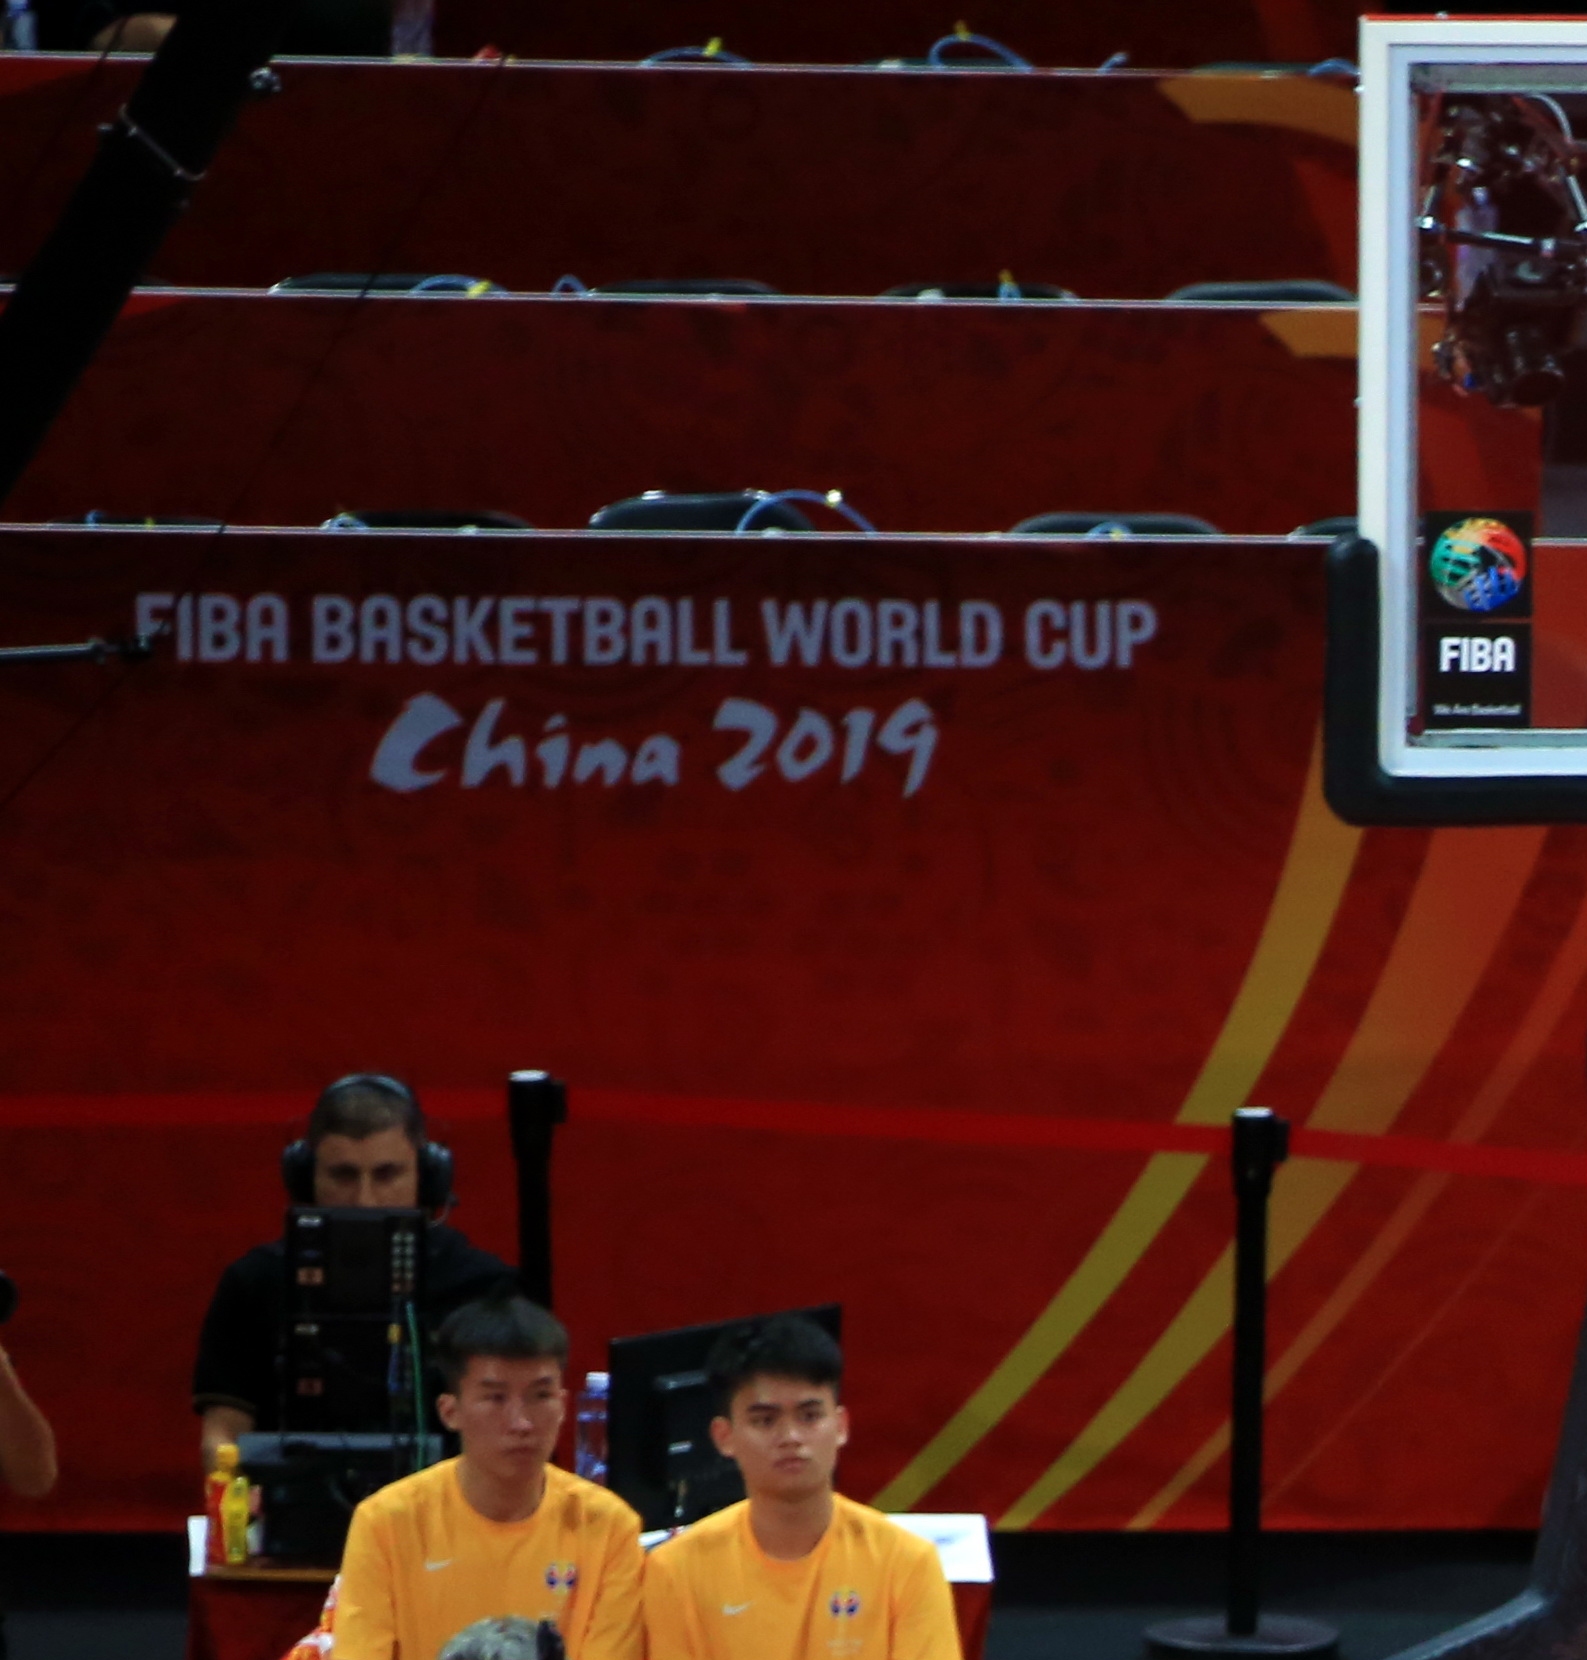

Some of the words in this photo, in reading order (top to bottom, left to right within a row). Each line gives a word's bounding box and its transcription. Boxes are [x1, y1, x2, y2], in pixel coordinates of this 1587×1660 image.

[135, 592, 289, 663] FIBA
[311, 593, 748, 667] BASKETBALL
[761, 597, 1003, 669] WORLD
[1023, 598, 1158, 671] CUP
[1438, 635, 1516, 673] FIBA
[369, 692, 680, 793] China
[712, 697, 939, 797] 2019
